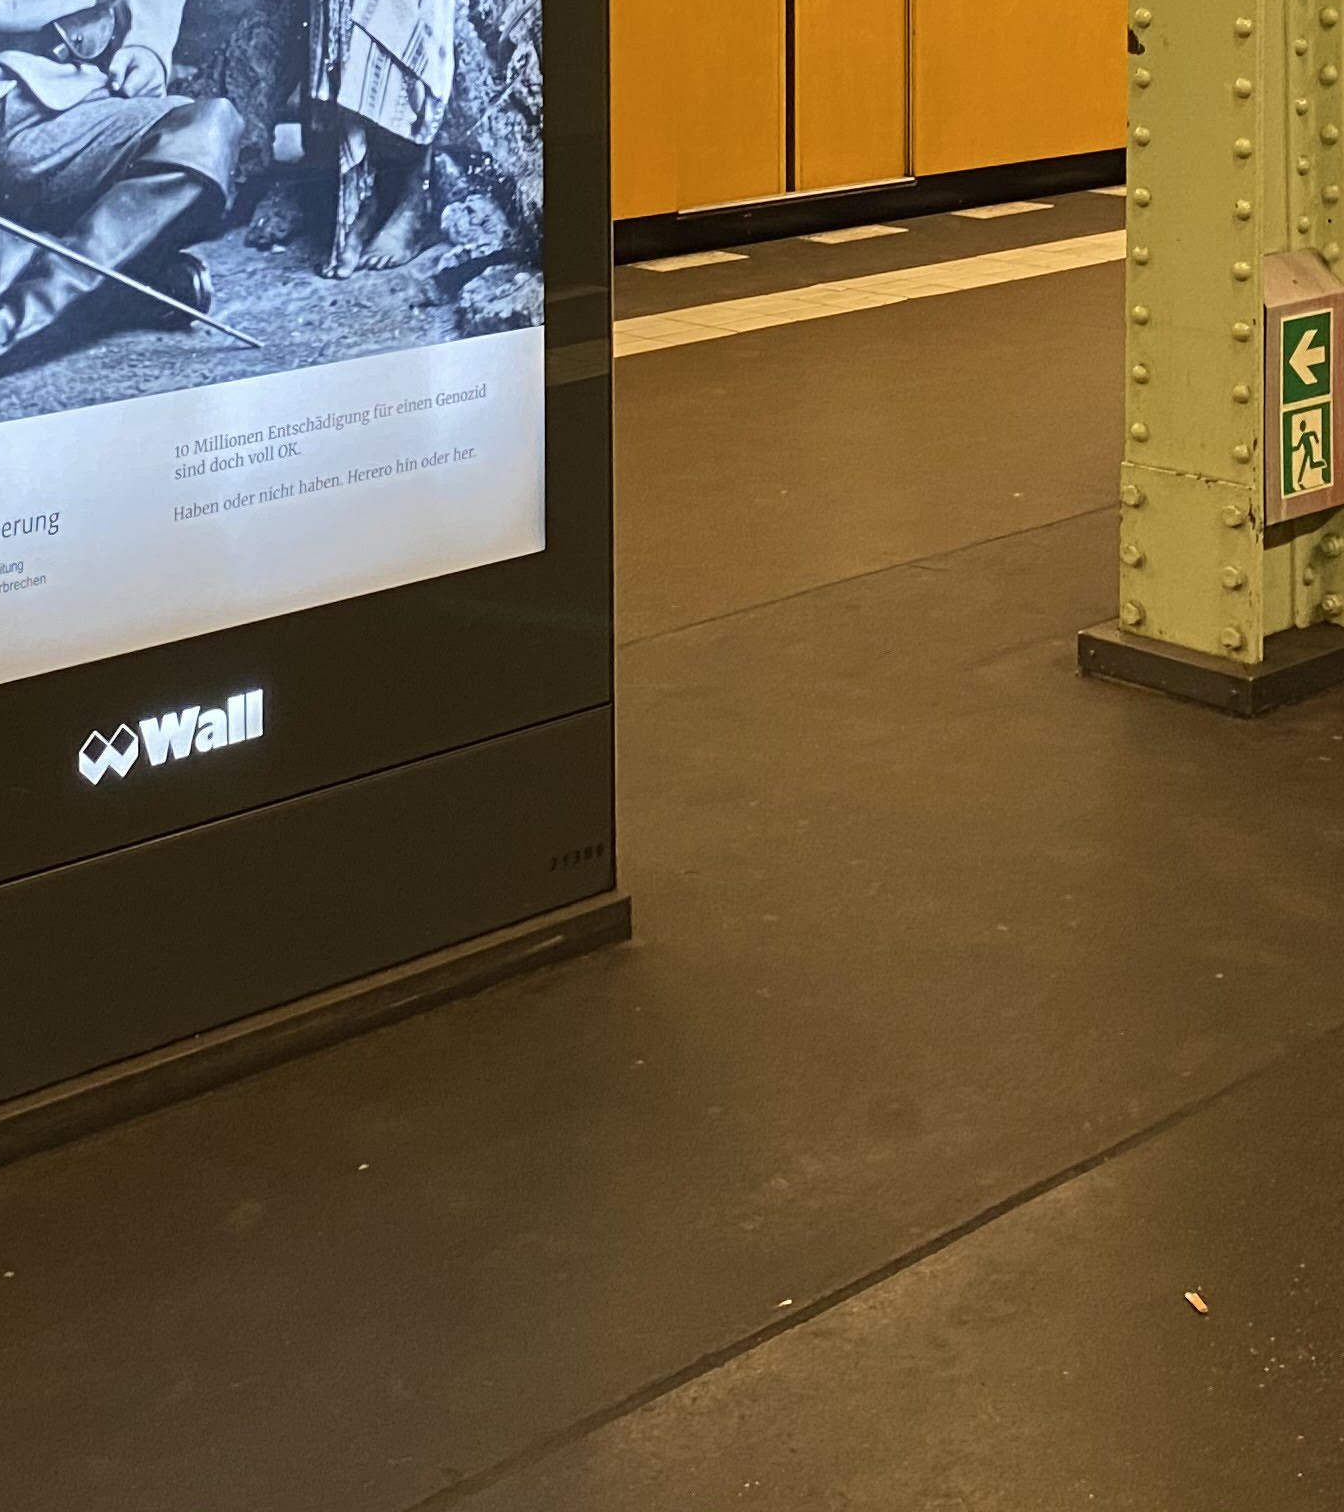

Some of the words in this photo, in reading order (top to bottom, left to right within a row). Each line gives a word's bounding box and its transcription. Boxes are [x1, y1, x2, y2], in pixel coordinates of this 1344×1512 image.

[174, 443, 190, 459] 10
[194, 429, 264, 455] Millionen
[268, 406, 371, 441] Entschädigung
[373, 402, 393, 420] für
[397, 396, 433, 415] einen
[436, 384, 487, 407] Genozid
[173, 499, 219, 522] Haben
[223, 491, 255, 512] oder
[259, 483, 294, 503] nicht
[298, 473, 344, 495] haben.
[348, 464, 393, 485] Herero
[396, 457, 418, 475] hin
[421, 450, 450, 468] oder
[174, 458, 206, 480] sind
[210, 453, 245, 474] doch
[248, 446, 275, 465] voll
[138, 688, 264, 767] Wall
